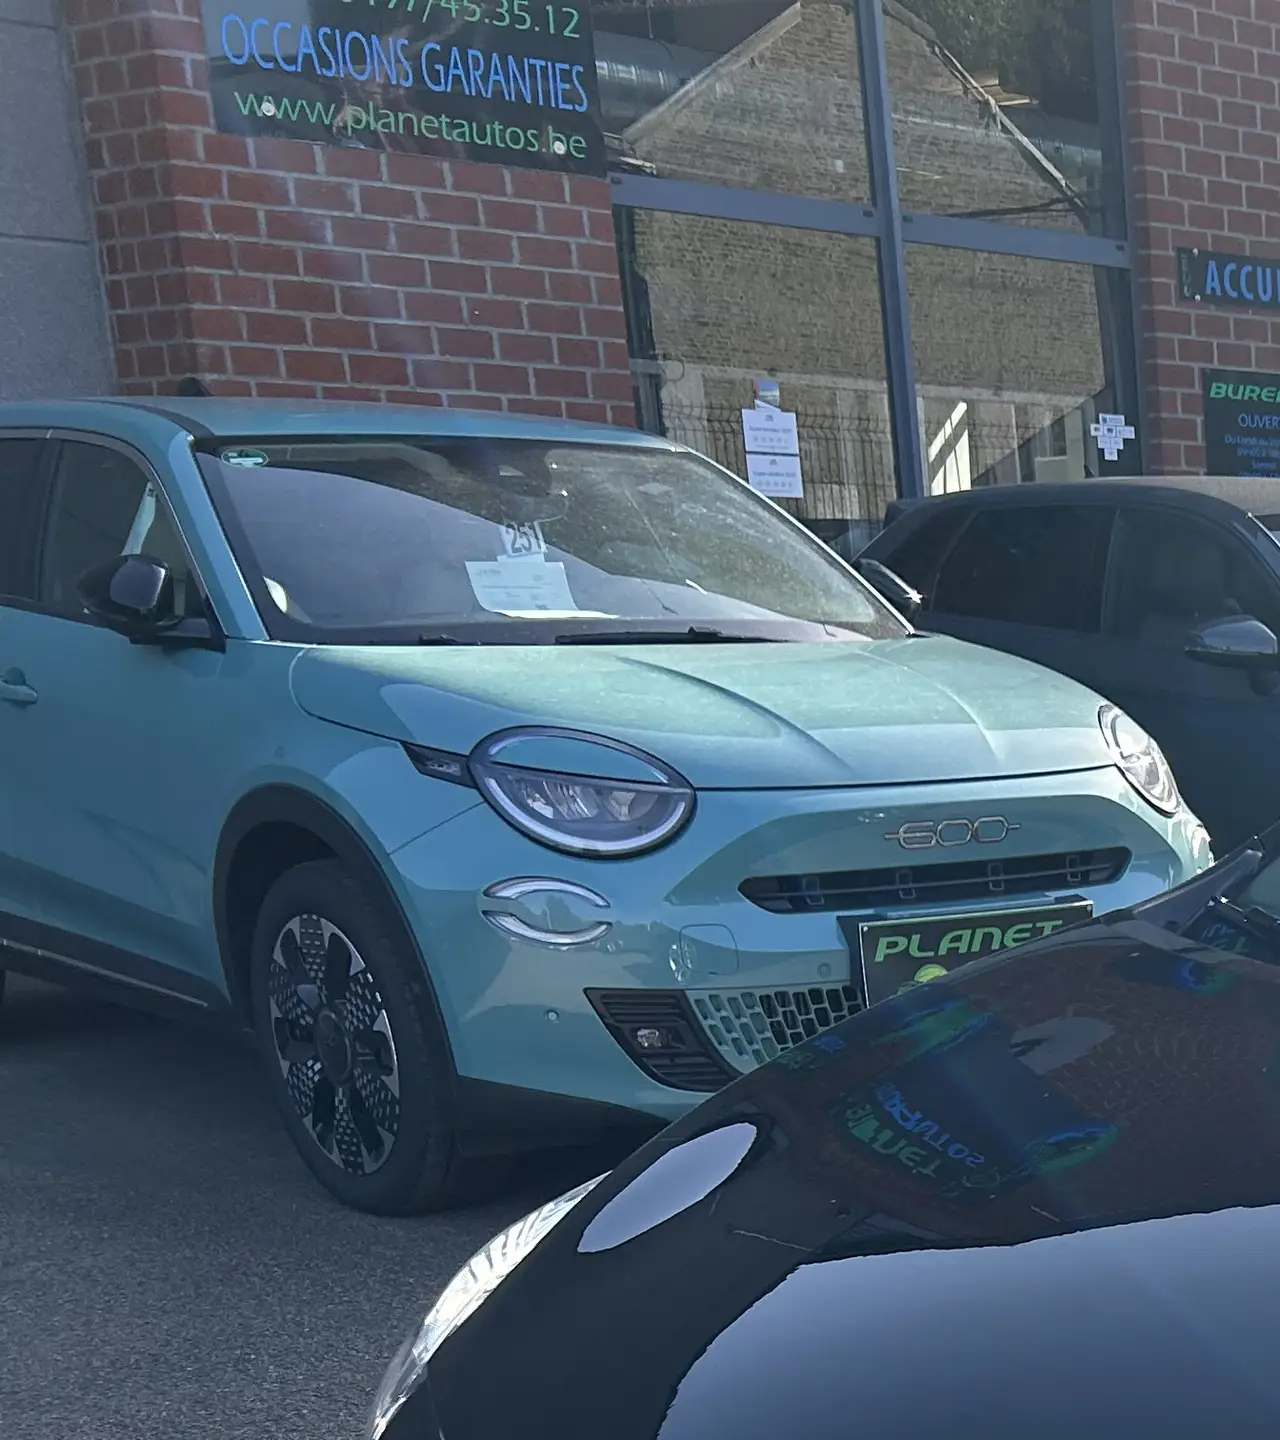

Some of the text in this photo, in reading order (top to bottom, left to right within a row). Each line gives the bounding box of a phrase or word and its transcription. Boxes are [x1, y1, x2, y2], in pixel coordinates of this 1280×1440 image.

[220, 13, 588, 113] OCCASIONS GARANTIES
[874, 919, 1064, 963] PLANET
